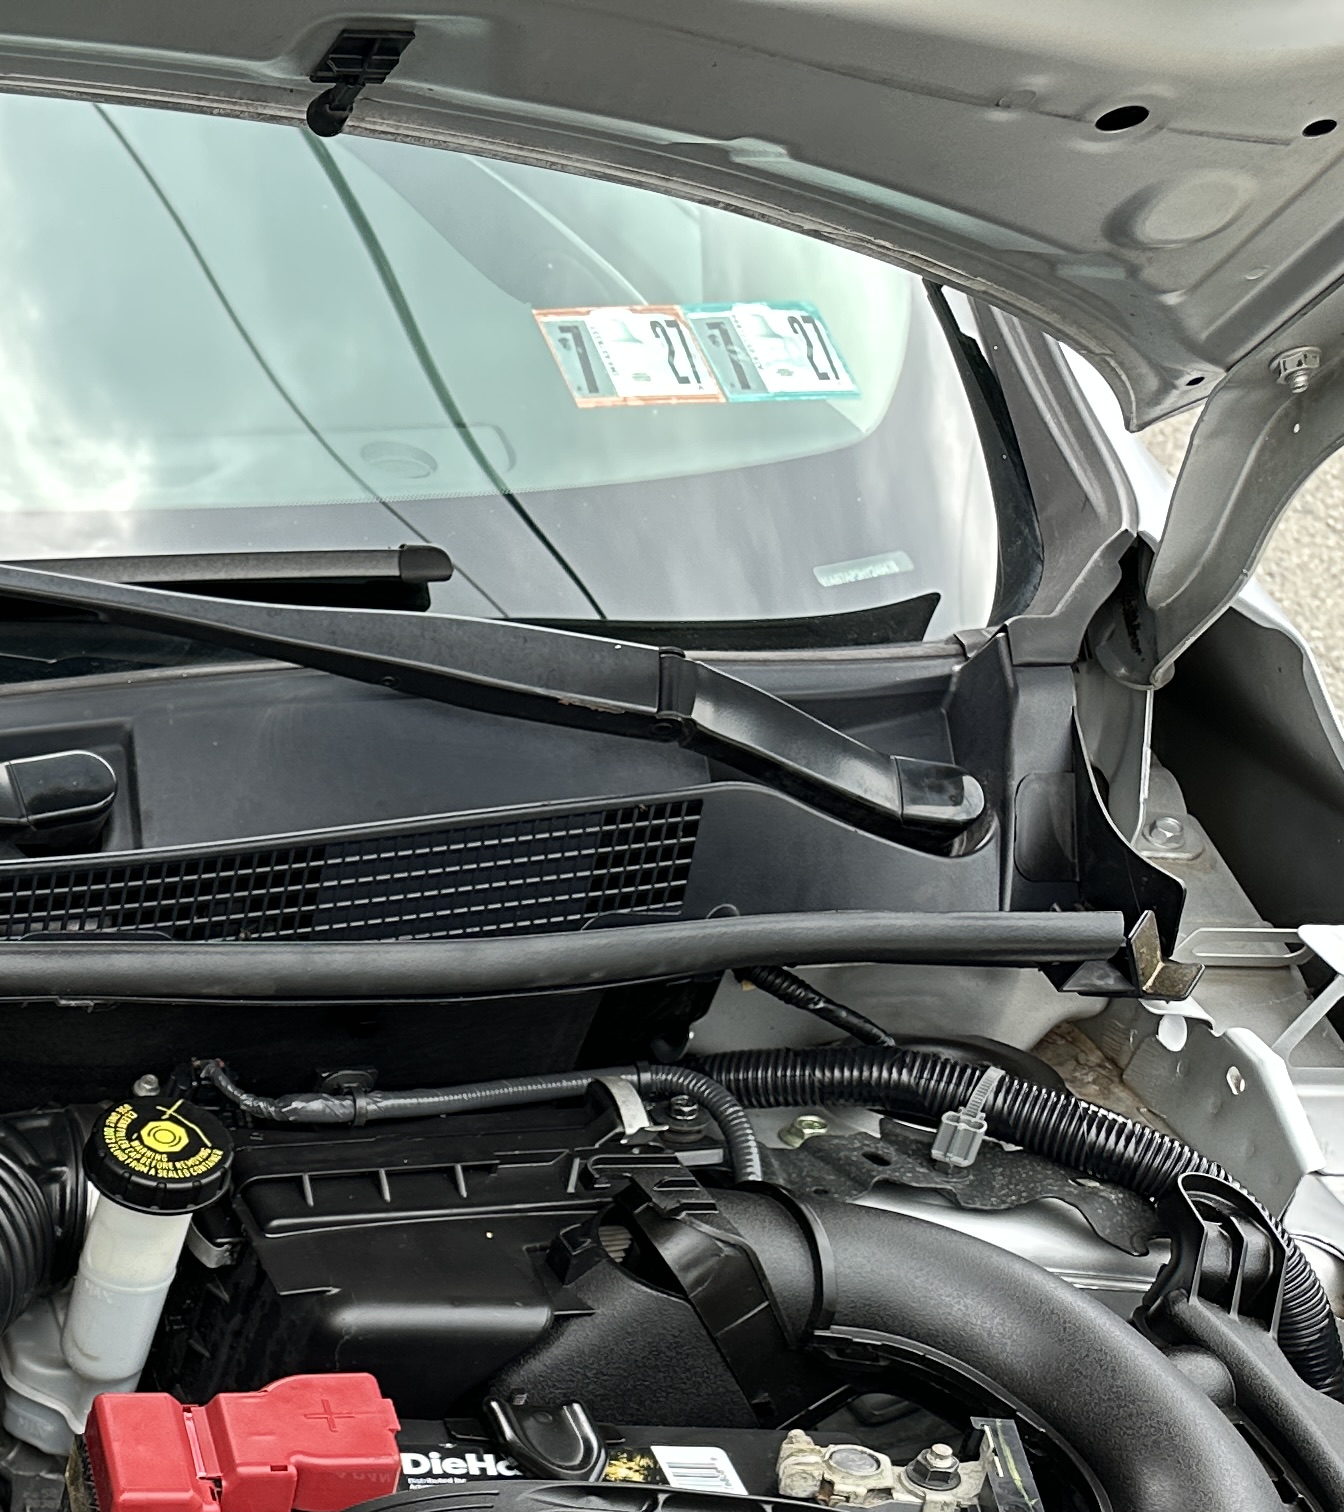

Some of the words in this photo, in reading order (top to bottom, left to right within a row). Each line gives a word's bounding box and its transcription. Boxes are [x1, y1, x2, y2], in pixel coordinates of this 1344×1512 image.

[650, 319, 702, 384] 27
[787, 314, 840, 380] 27
[399, 1451, 524, 1477] DieHa
